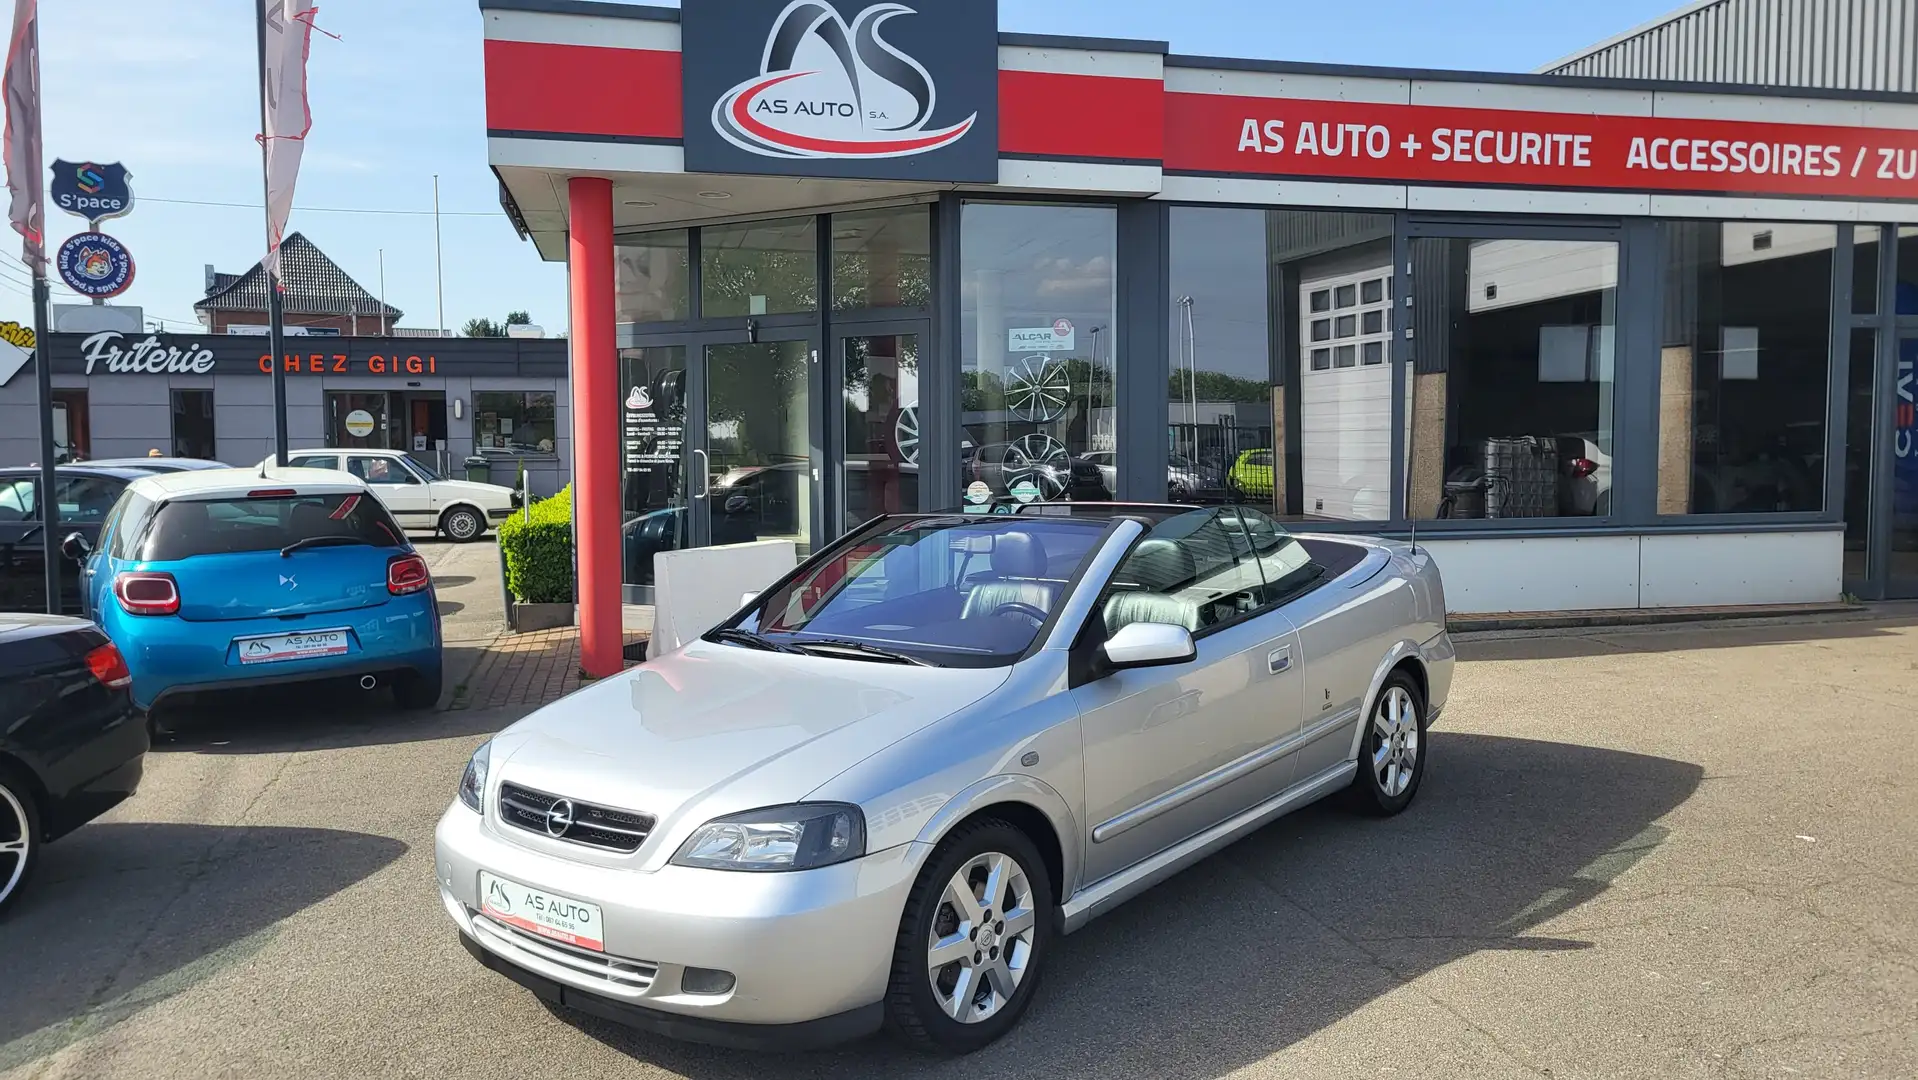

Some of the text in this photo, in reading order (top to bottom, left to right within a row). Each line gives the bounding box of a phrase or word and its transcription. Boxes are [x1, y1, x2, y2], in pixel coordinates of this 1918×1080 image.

[755, 98, 788, 114] AS
[793, 101, 854, 117] AUTO
[1237, 118, 1592, 167] AS AUTO + SECURITE
[1626, 137, 1917, 179] ACCESSOIRES / ZU
[60, 194, 121, 209] S'pace
[66, 234, 120, 252] S'pace kids
[60, 250, 70, 270] kids
[1012, 333, 1052, 341] ALCAR
[81, 331, 435, 375] Friterie CHEZ GIGI
[285, 634, 338, 645] AS AUTO
[525, 893, 545, 911] AS
[548, 900, 590, 923] AUTO
